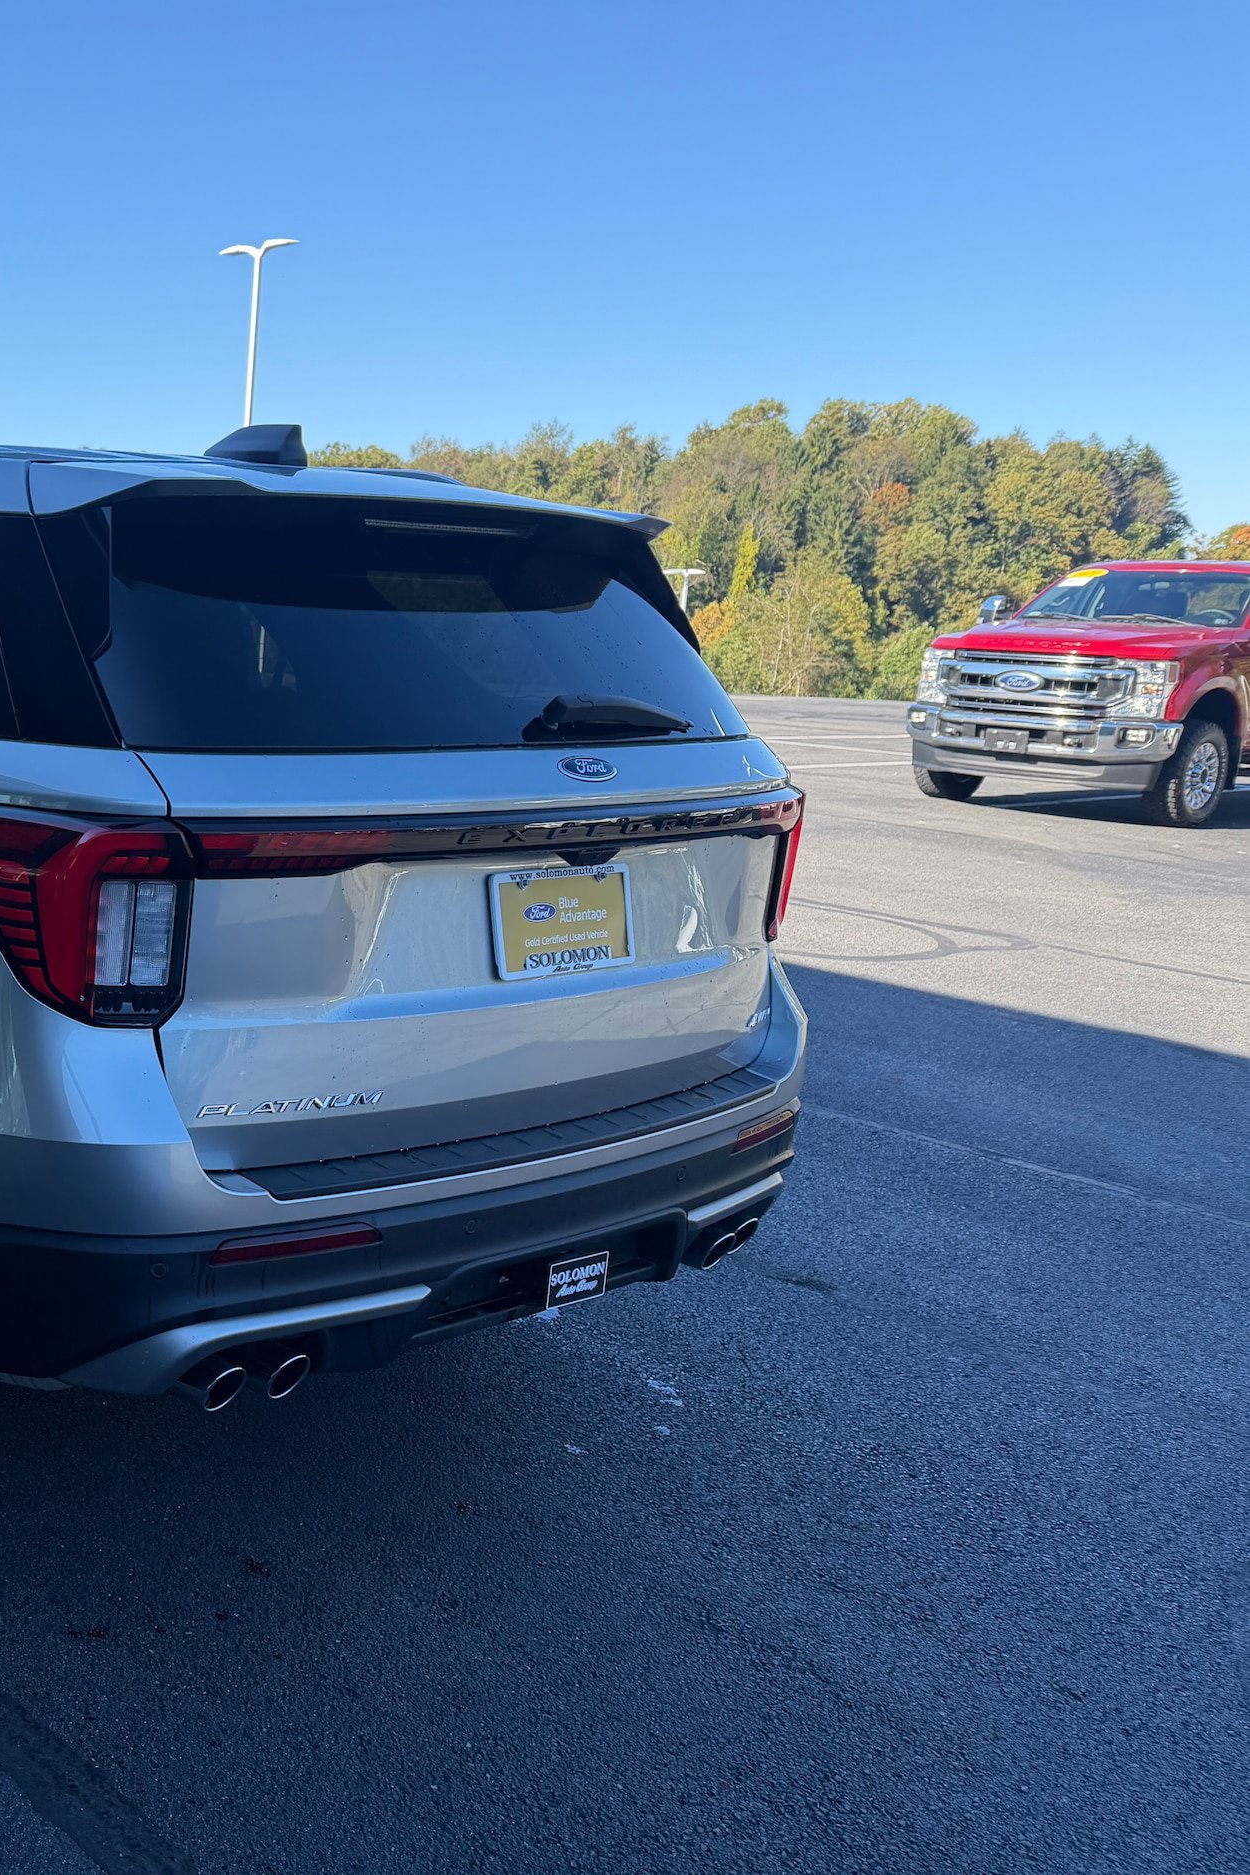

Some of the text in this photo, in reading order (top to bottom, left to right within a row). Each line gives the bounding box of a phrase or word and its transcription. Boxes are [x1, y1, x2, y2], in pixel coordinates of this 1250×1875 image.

[574, 758, 607, 774] Ford
[509, 864, 615, 881] www.solomonauto.com
[558, 896, 579, 909] Blue
[529, 905, 551, 920] Ford
[559, 908, 607, 924] Advantage
[524, 929, 609, 948] Gold Certified Used Vehicle
[529, 944, 611, 969] SOLOMON
[196, 1089, 385, 1119] PLATINUM
[550, 1261, 607, 1287] SOLOMON
[555, 1283, 577, 1299] Auto
